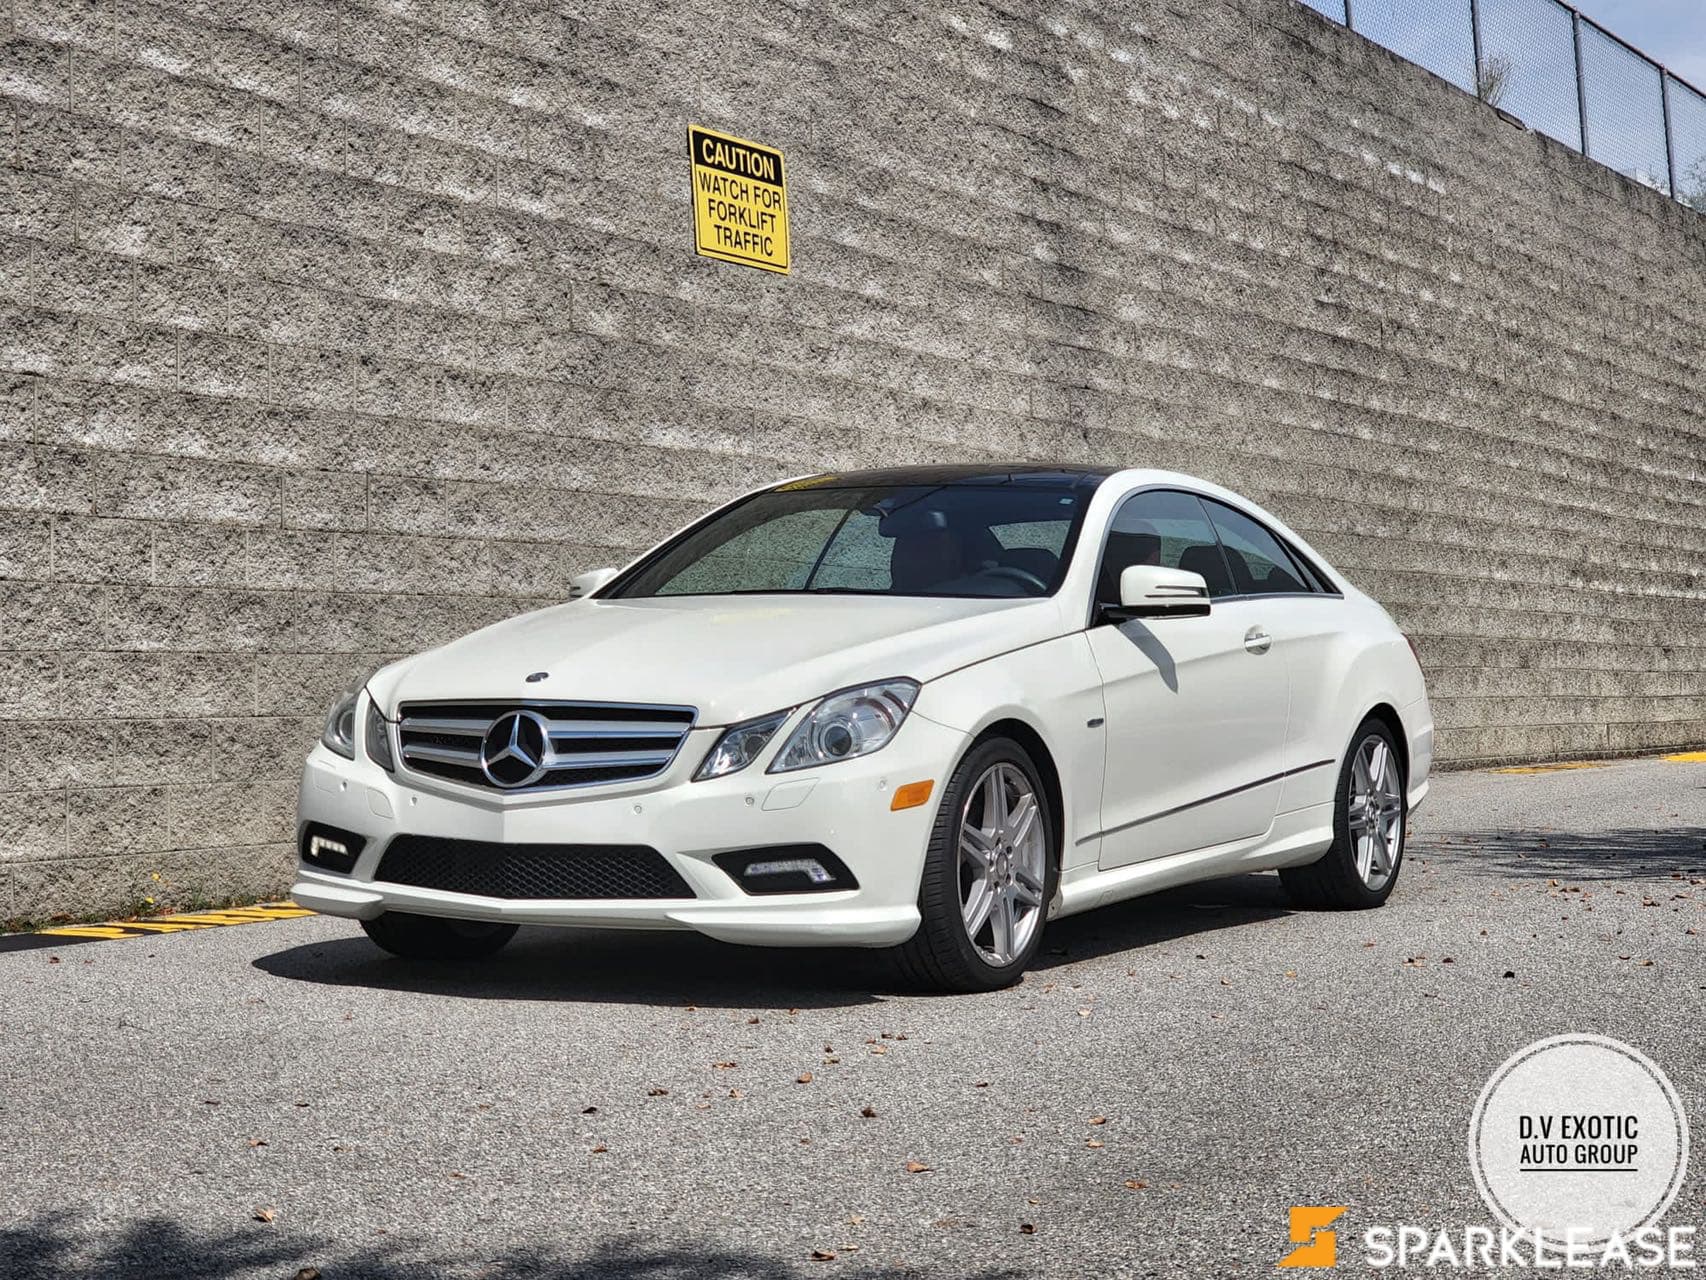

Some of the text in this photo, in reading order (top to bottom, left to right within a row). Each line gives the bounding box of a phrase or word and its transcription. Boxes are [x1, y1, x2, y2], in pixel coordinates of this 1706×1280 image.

[702, 139, 775, 180] CAUTION
[698, 170, 782, 211] WATCH FOR
[708, 198, 776, 233] FORKLIFT
[714, 224, 773, 257] TRAFFIC
